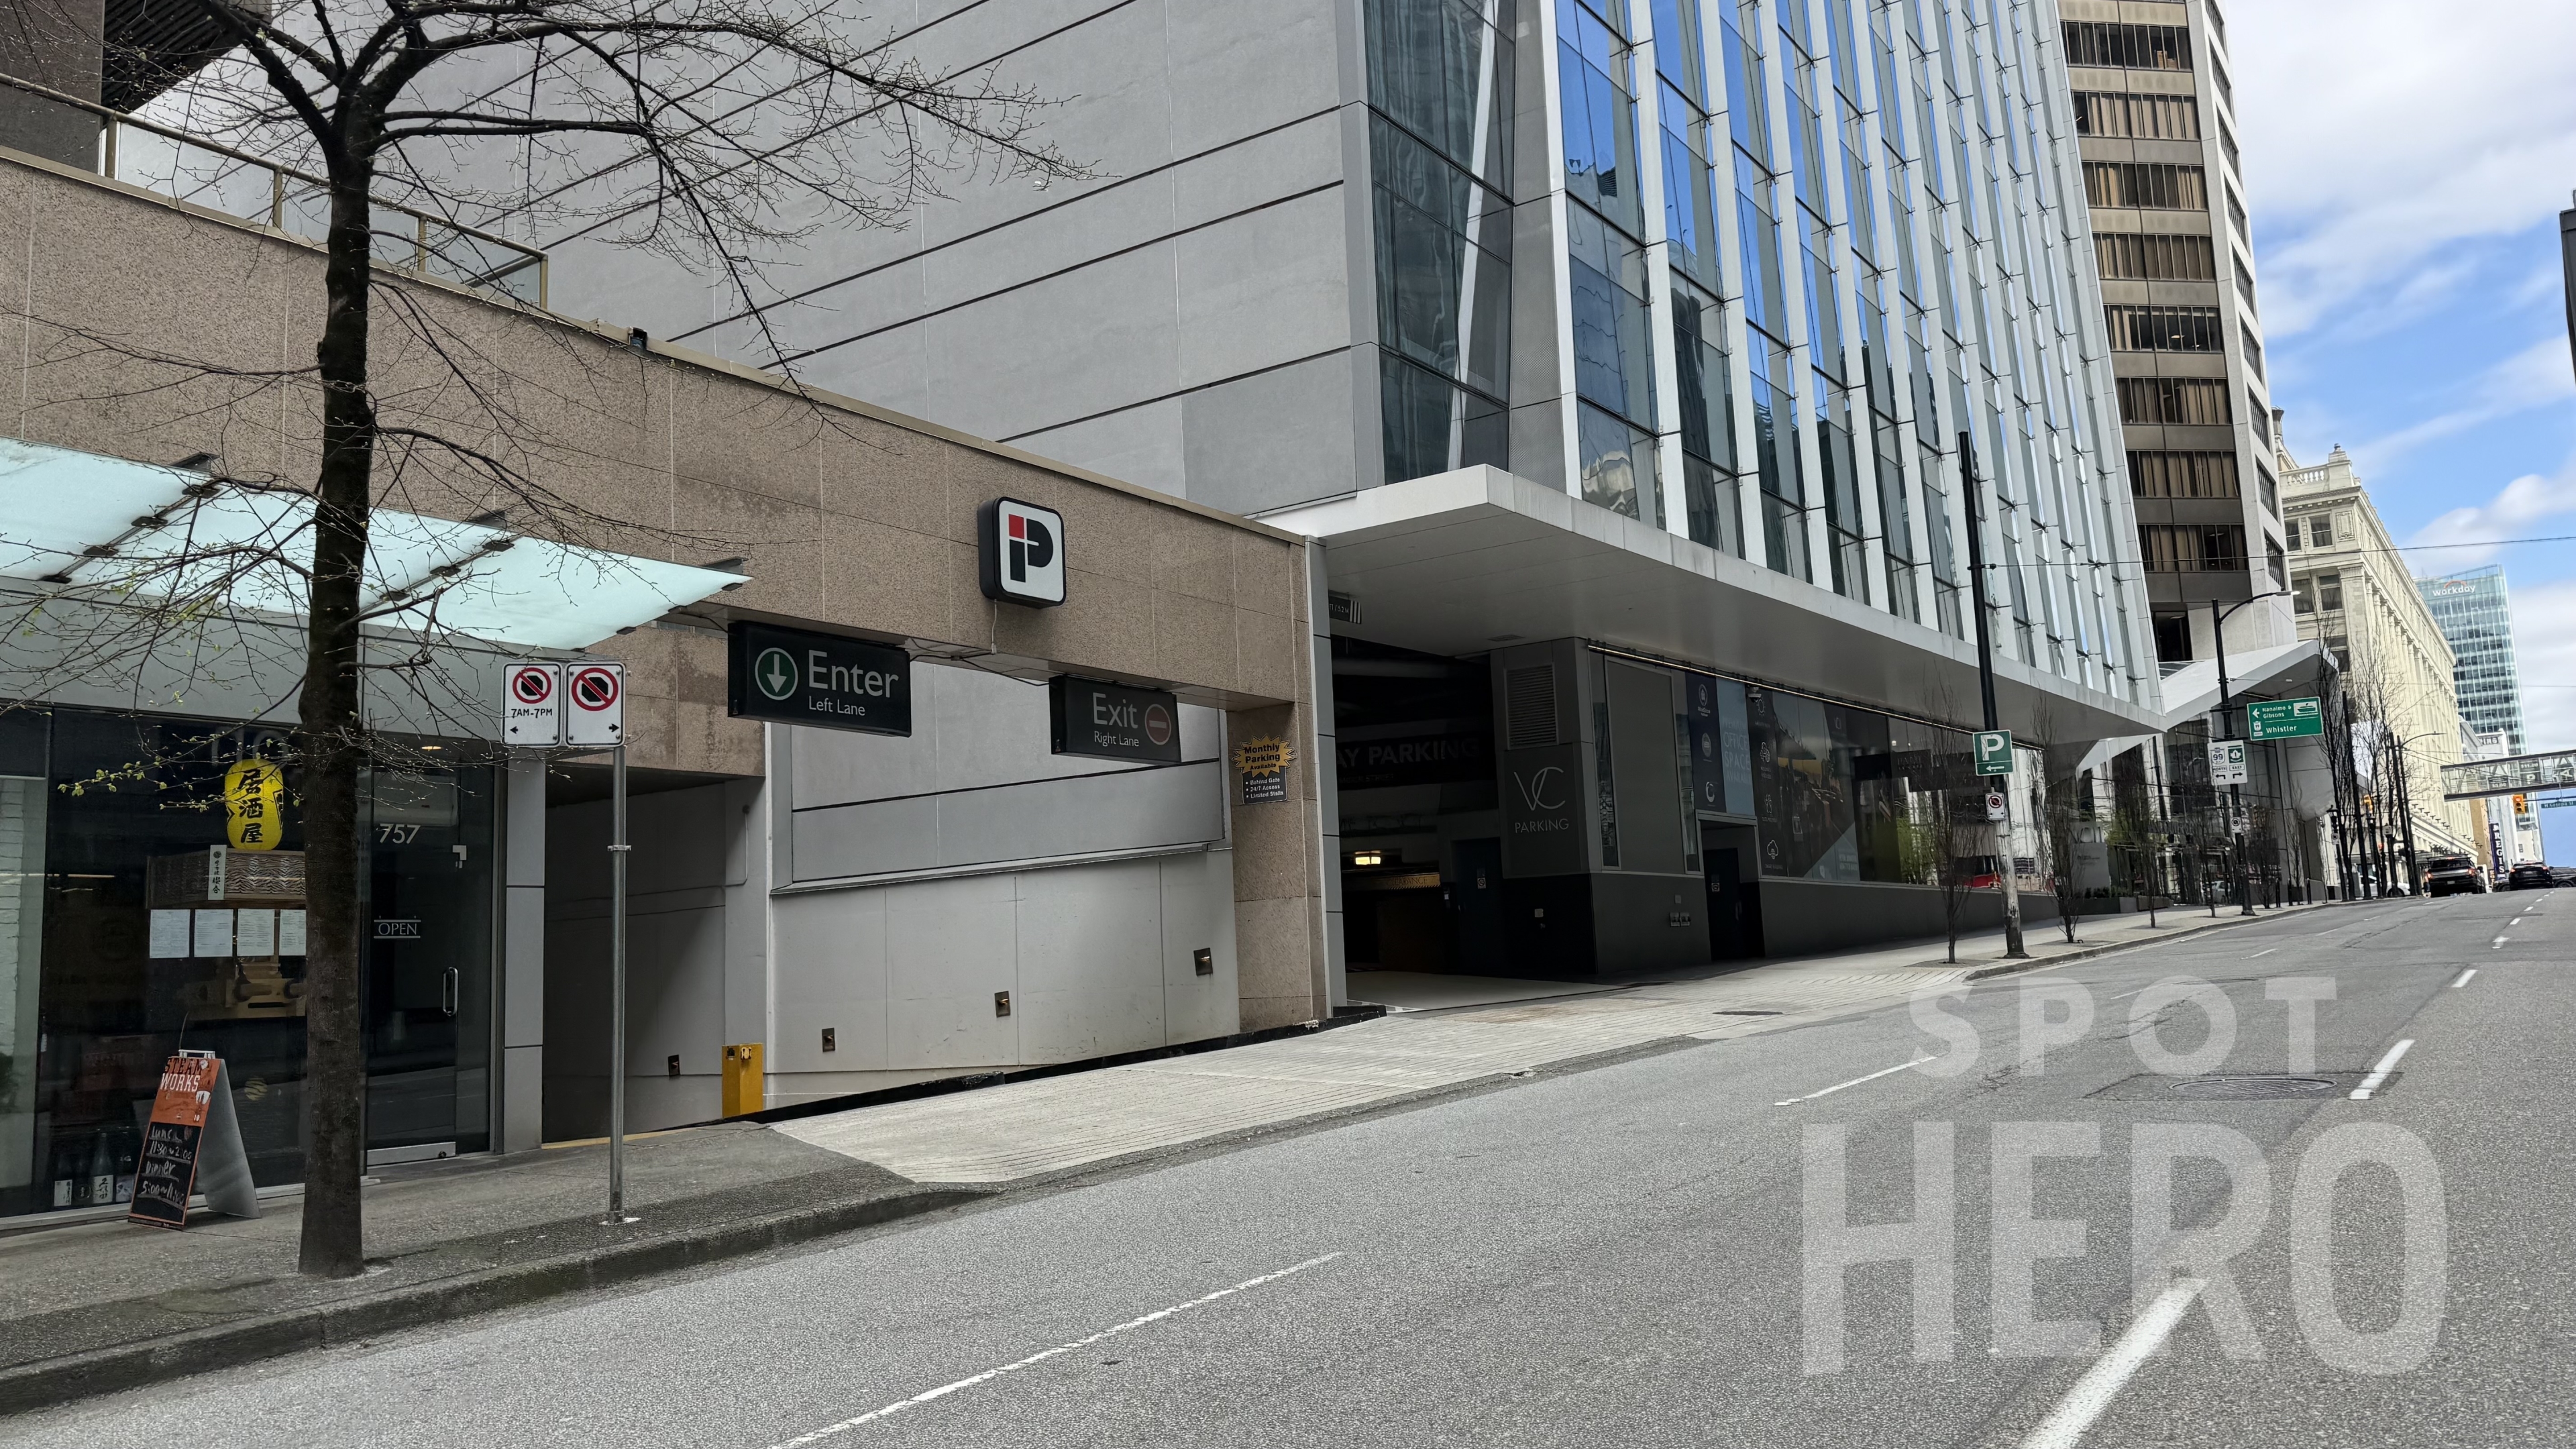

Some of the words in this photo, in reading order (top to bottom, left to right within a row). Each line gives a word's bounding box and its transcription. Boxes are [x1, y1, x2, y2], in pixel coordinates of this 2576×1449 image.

[2432, 585, 2476, 596] workday
[808, 649, 899, 698] Enter
[511, 708, 552, 718] 7AM-7PM
[808, 696, 833, 712] Left
[837, 699, 865, 716] Lane
[1093, 692, 1138, 729] Exit
[1094, 731, 1116, 747] Right
[1119, 733, 1139, 747] Lane
[2265, 725, 2297, 734] Whistler
[1244, 743, 1280, 754] Monthly
[1723, 731, 1749, 751] OFFICE
[1980, 734, 2004, 761] P
[1245, 753, 1280, 763] Parking
[1368, 737, 1480, 766] PARKING
[1724, 751, 1751, 771] SPACE
[1513, 766, 1566, 811] VC
[237, 768, 264, 843] 居酒屋
[379, 823, 421, 844] 757
[1514, 818, 1569, 833] PARKING
[2493, 832, 2506, 873] REGIS
[378, 922, 417, 936] OPEN
[164, 1057, 204, 1075] STEAM
[160, 1073, 201, 1093] WORKS
